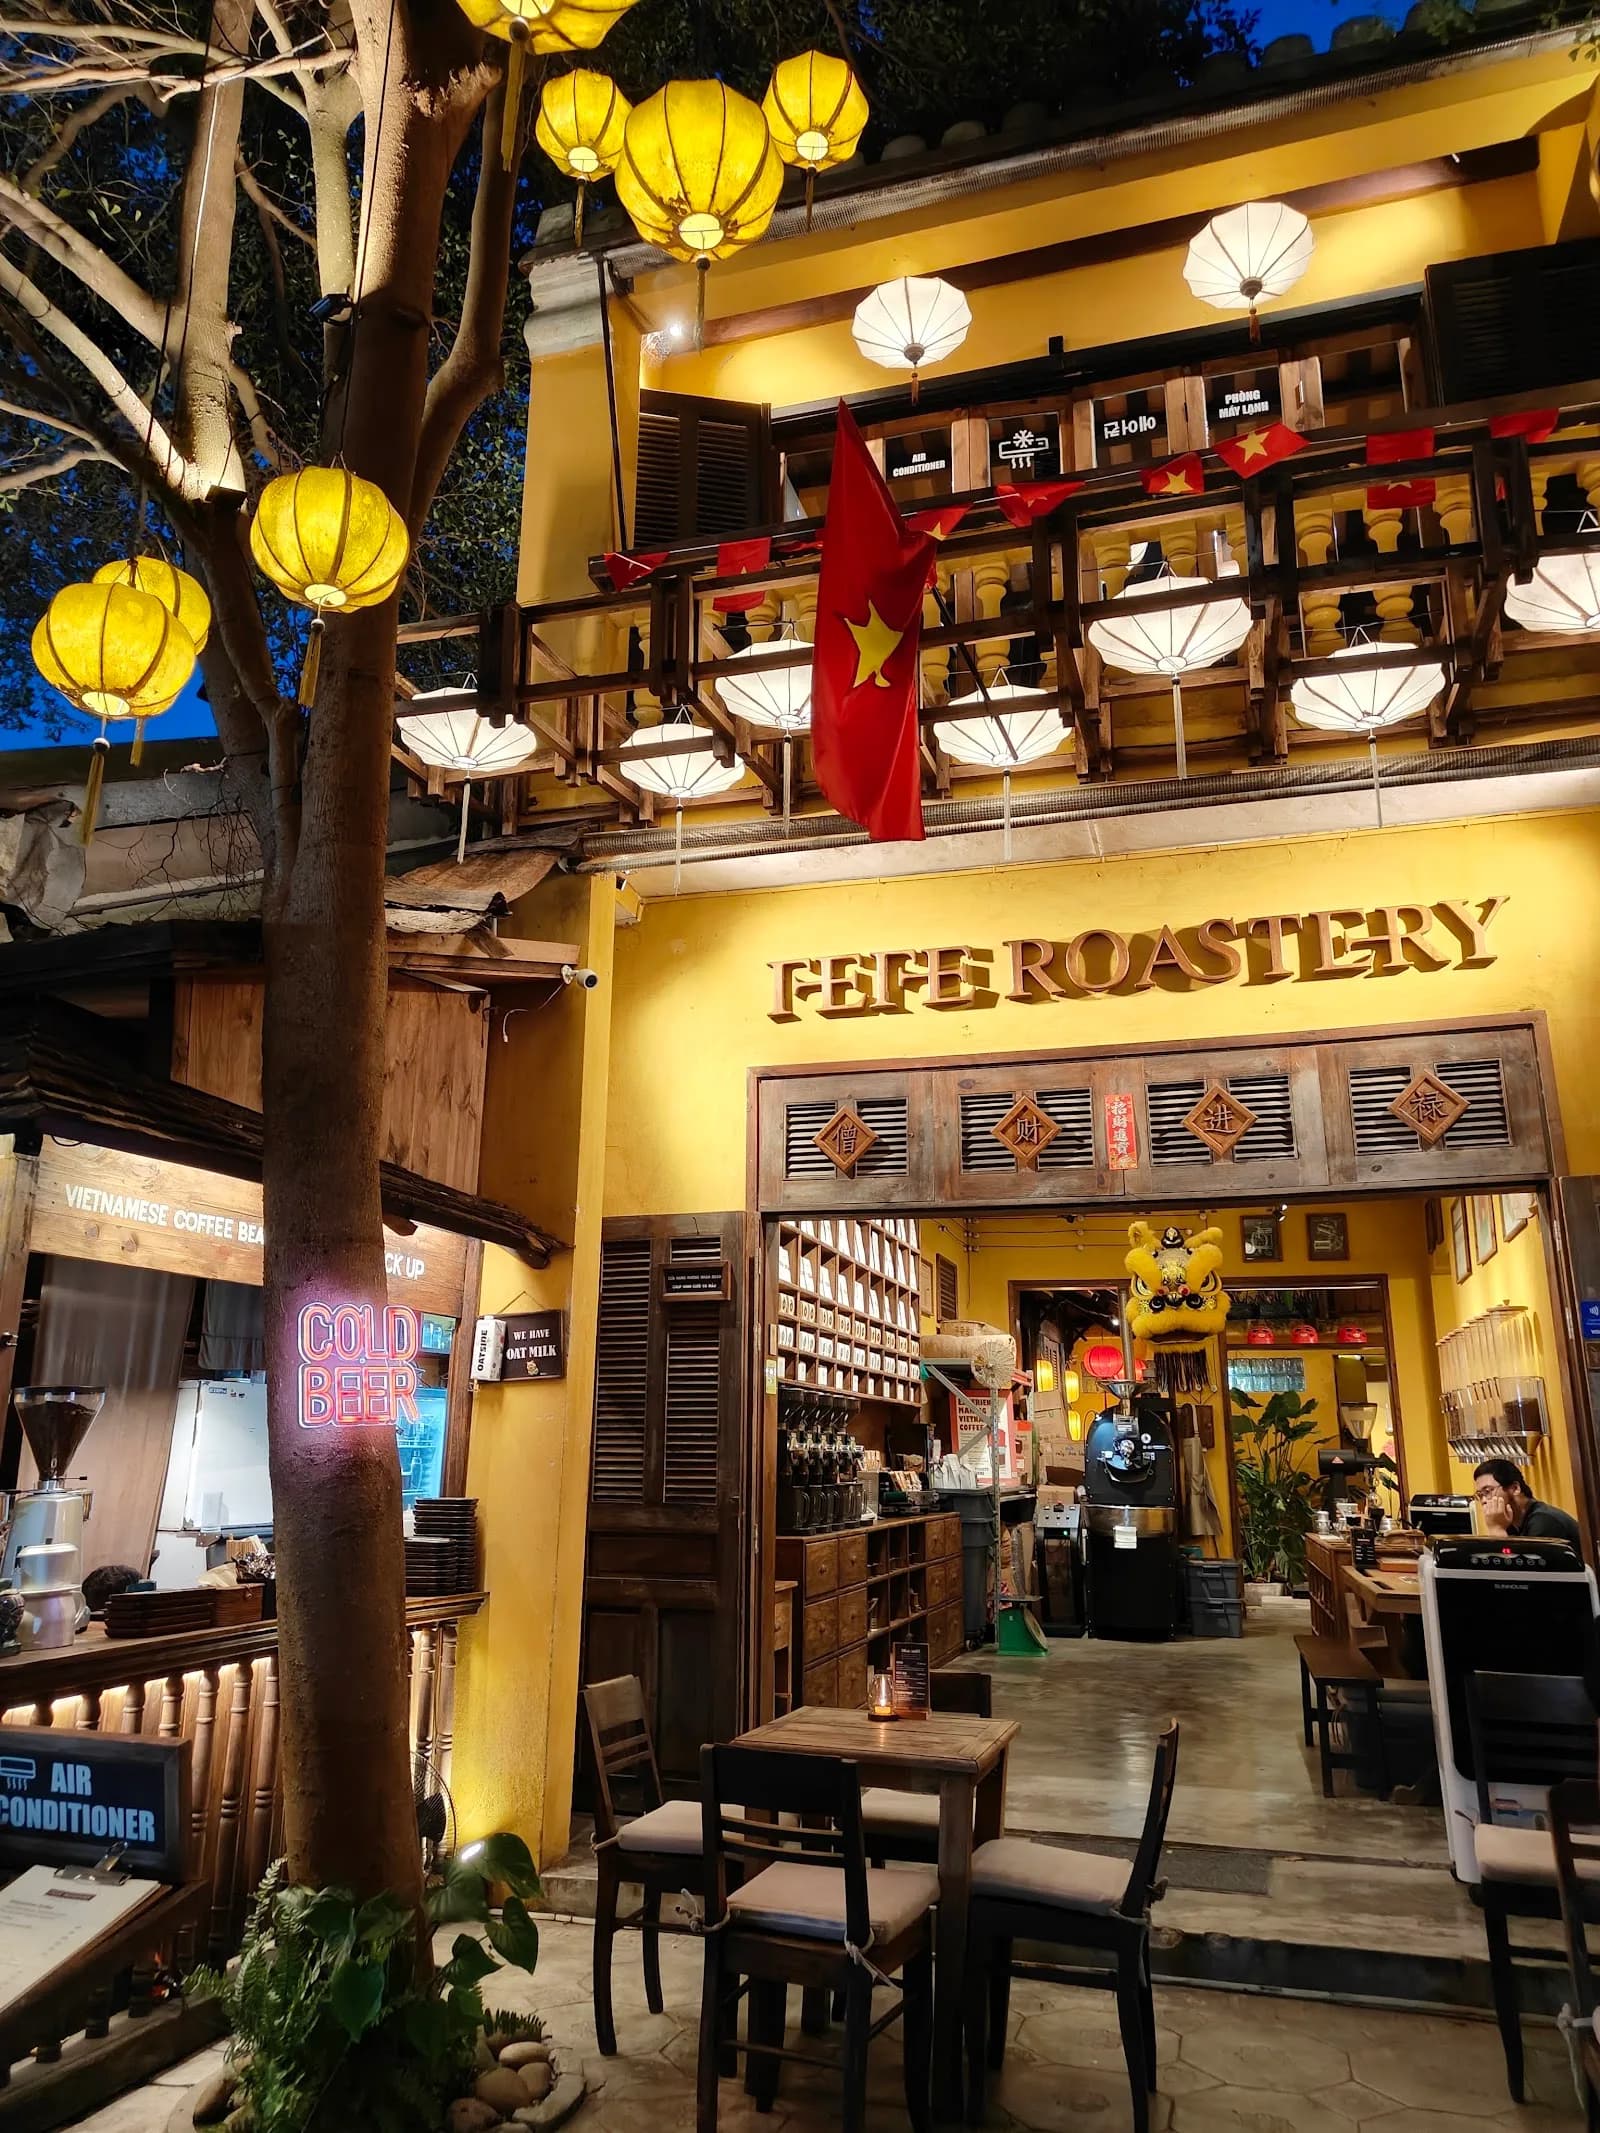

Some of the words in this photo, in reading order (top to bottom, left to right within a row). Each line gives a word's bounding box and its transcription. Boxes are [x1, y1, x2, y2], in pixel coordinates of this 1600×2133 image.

[1219, 405, 1240, 418] MÁY
[1242, 401, 1269, 415] LẠNH
[1225, 390, 1260, 404] PHÒNG
[893, 460, 945, 477] CONDITIONER
[912, 453, 926, 463] AIR
[767, 945, 977, 1023] FEFE
[1002, 896, 1510, 1001] ROASTERY
[1203, 1103, 1237, 1133] 进
[1410, 1090, 1449, 1122] 禄
[1014, 1115, 1041, 1145] 财
[65, 1184, 169, 1226] VIETNAMESE
[173, 1209, 234, 1239] COFFEE
[237, 1221, 264, 1244] BEA
[385, 1252, 403, 1276] CK
[405, 1256, 425, 1280] UP
[299, 1303, 418, 1361] COLD
[513, 1331, 527, 1341] WE
[529, 1329, 550, 1339] HAVE
[477, 1329, 488, 1371] OATSIDE
[506, 1347, 527, 1360] OAT
[528, 1345, 557, 1358] MILK
[299, 1364, 419, 1427] BEER
[51, 1762, 92, 1796] AIR
[0, 1795, 156, 1842] CONDITIONER
